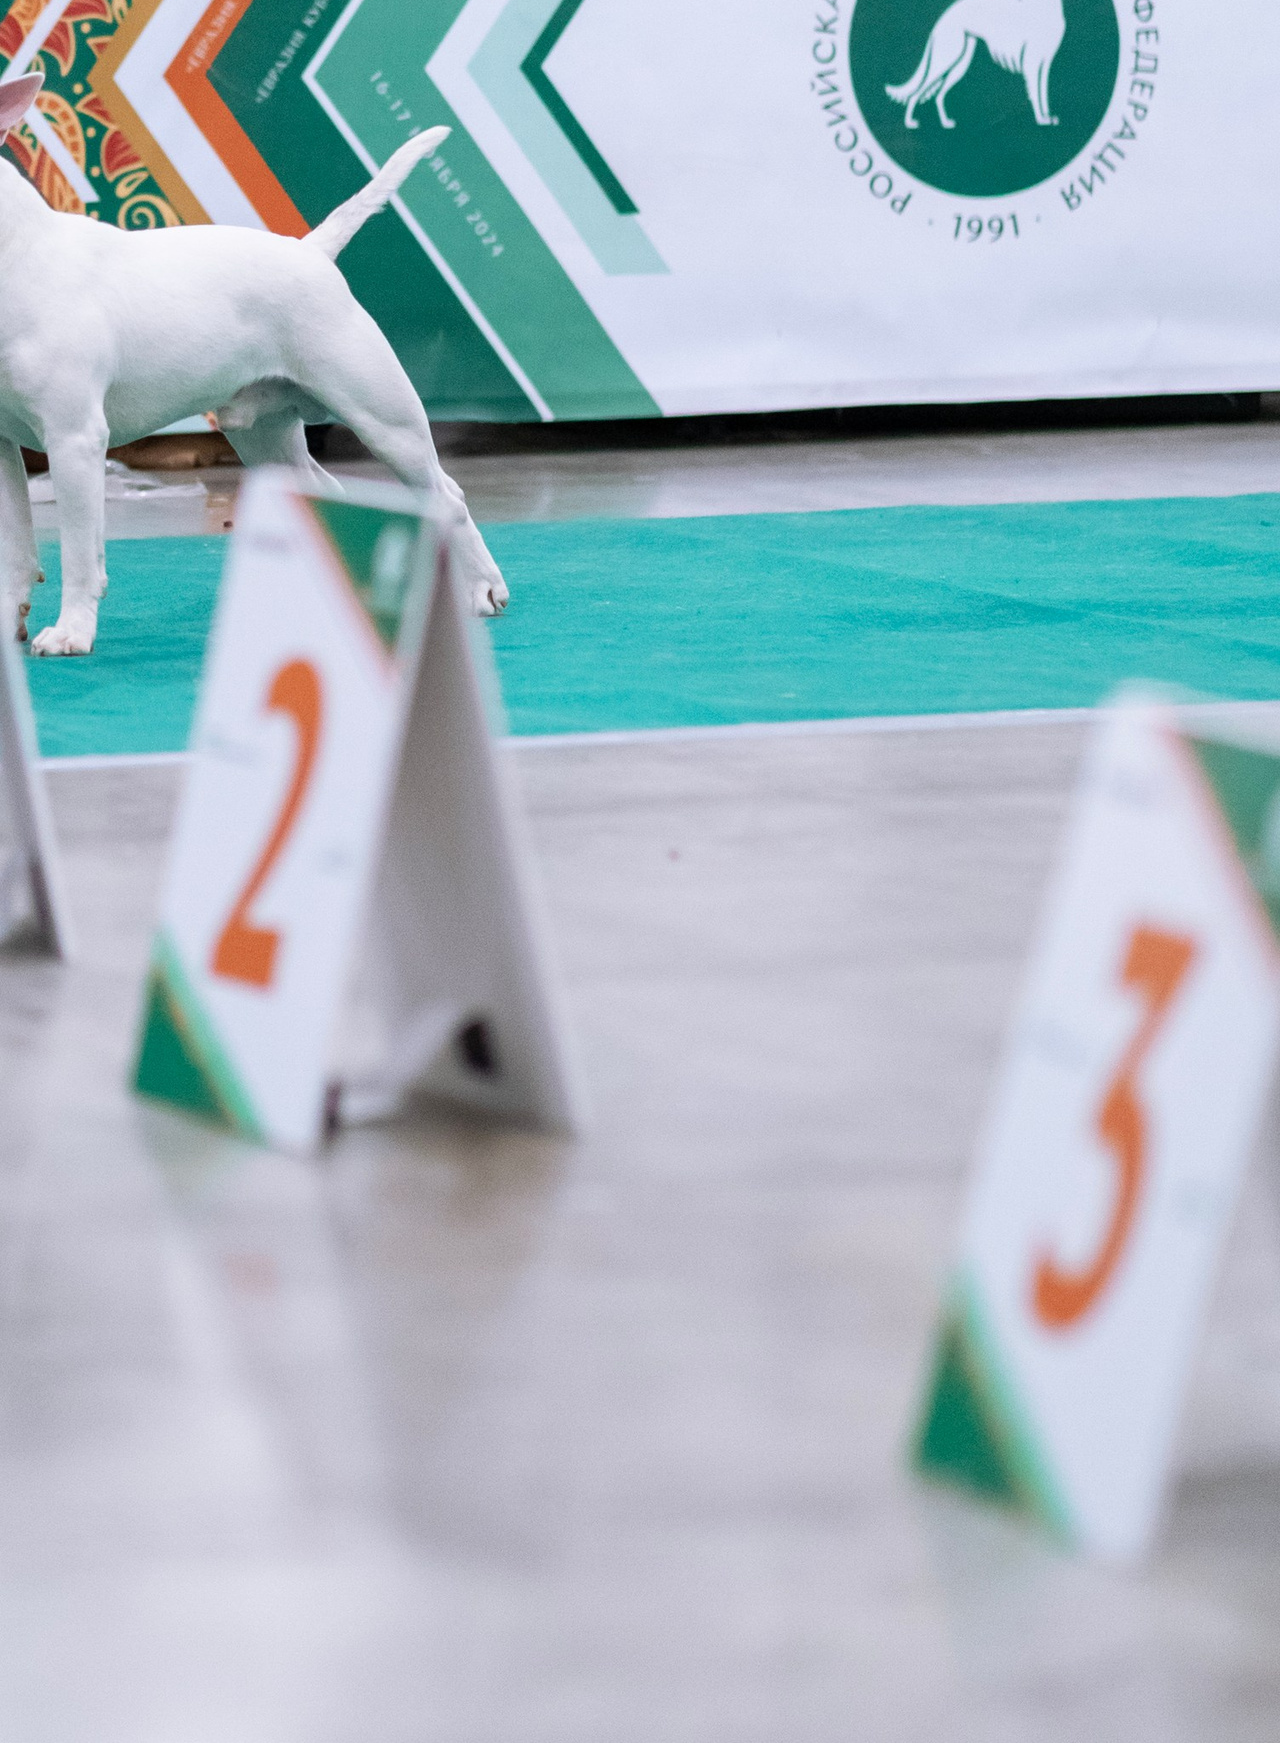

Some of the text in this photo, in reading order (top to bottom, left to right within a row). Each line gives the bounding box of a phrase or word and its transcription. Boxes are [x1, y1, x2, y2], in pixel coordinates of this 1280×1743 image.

[370, 70, 411, 122] 16-17
[467, 210, 504, 258] 2024
[954, 212, 1021, 244] 1991
[208, 657, 324, 990] 2
[1030, 921, 1201, 1331] 3
